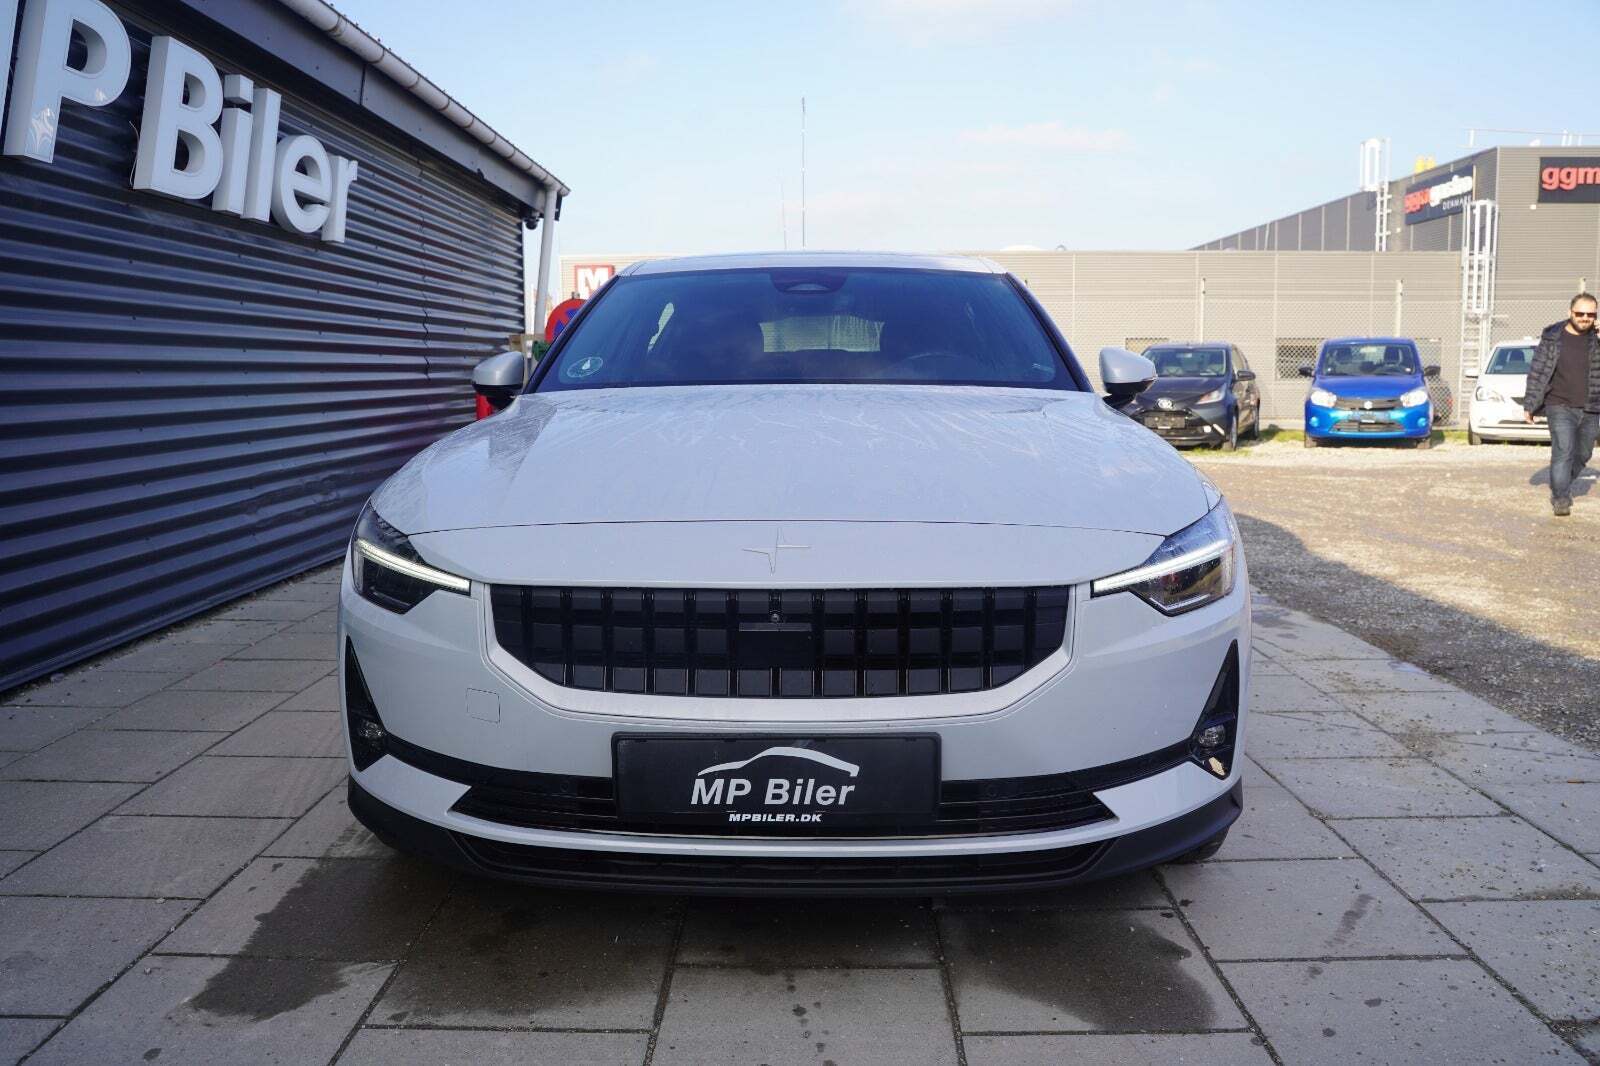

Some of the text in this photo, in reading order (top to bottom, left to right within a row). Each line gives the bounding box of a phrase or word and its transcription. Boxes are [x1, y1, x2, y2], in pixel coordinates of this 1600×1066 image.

[0, 0, 358, 243] P Biler
[1542, 167, 1600, 190] ggm
[690, 778, 855, 806] MP Biler
[728, 813, 822, 822] MPBILER.DK
